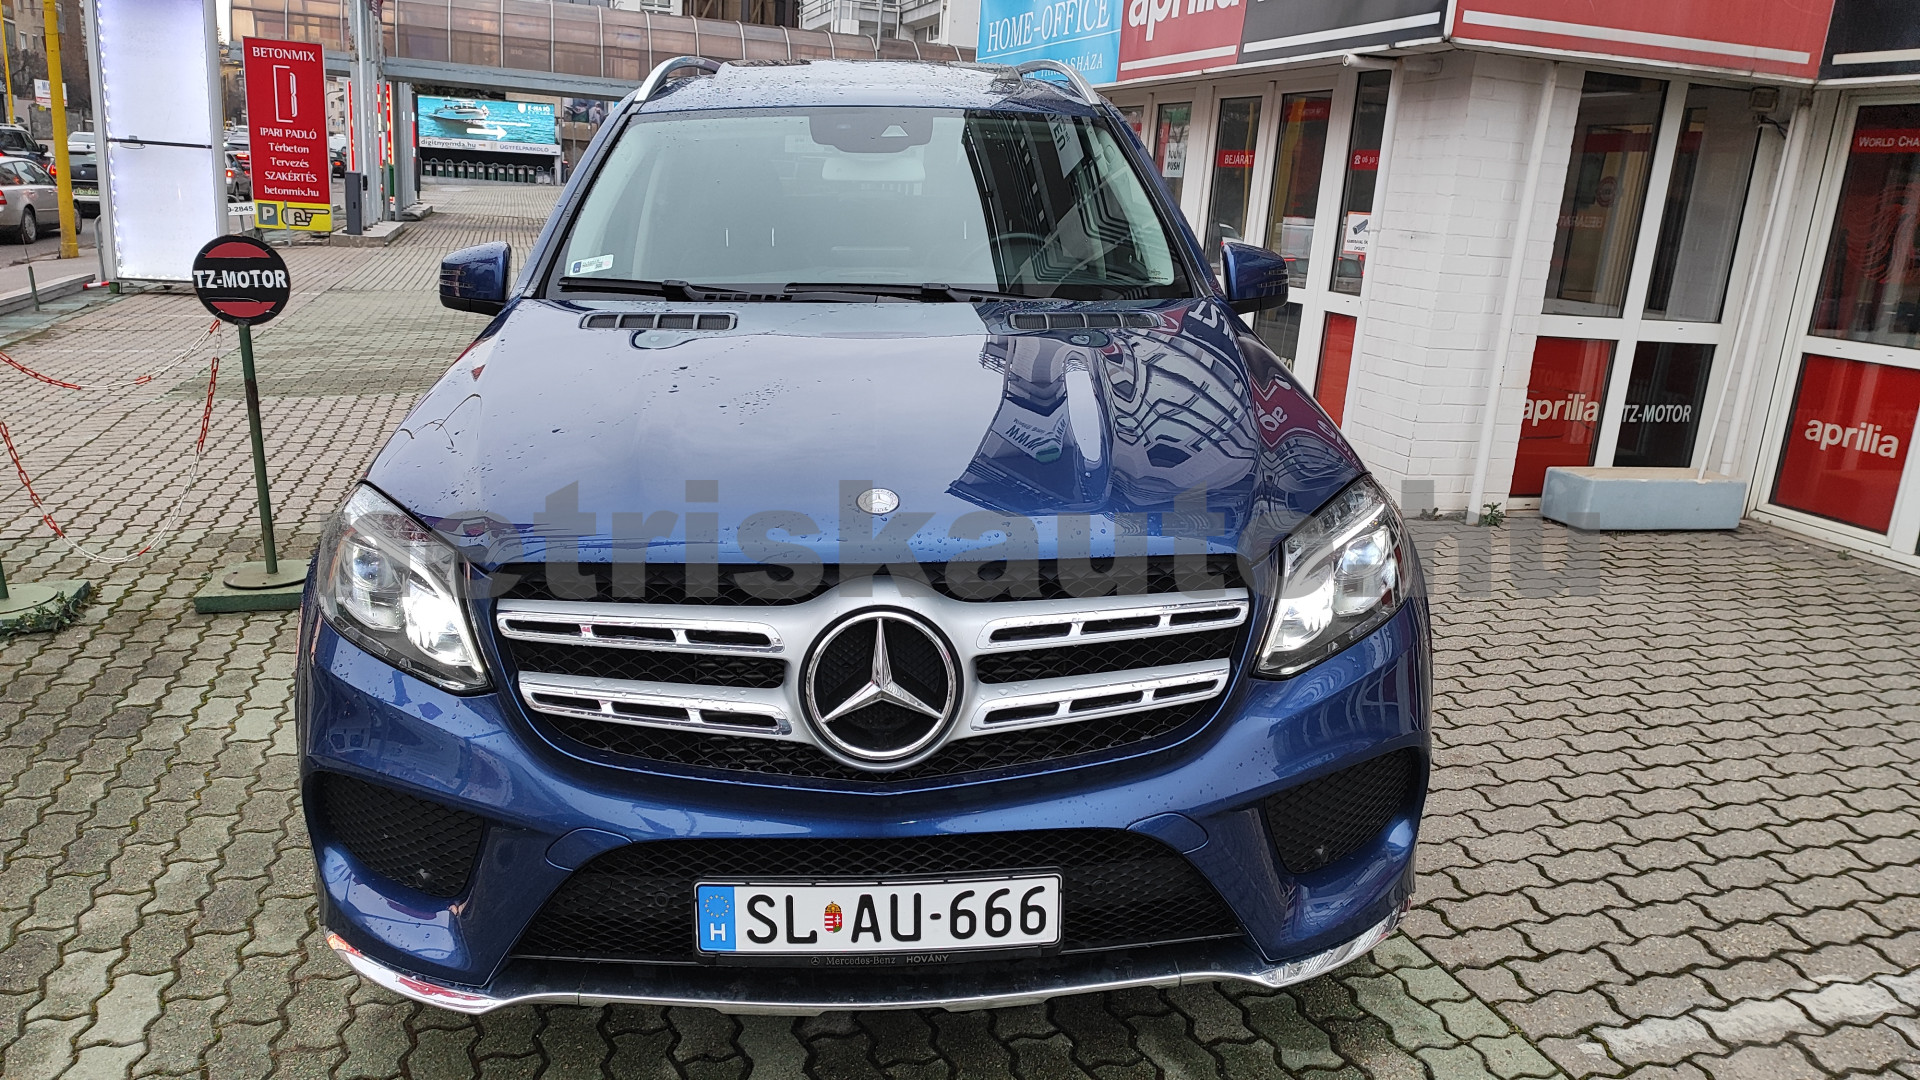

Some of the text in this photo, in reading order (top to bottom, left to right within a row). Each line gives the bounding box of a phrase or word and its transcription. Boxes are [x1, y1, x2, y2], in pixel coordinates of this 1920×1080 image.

[986, 0, 1110, 52] HOME-OFFICE
[252, 46, 316, 62] BETONMIX
[259, 127, 317, 139] IPARI PADLÓ
[268, 142, 309, 154] Térbeton
[421, 139, 476, 149] digitnyomda.hu
[1858, 136, 1896, 147] WORLD
[270, 157, 309, 168] Tervezés
[1224, 152, 1253, 165] BEJÁRAT
[1167, 161, 1181, 171] PUSH
[264, 170, 318, 183] SZAKÉRTÉS
[264, 185, 319, 197] betonmix.hu
[262, 206, 275, 221] P
[193, 269, 288, 289] TZ-MOTOR
[1522, 393, 1600, 426] aprilia
[1805, 418, 1900, 459] aprilia
[746, 885, 1047, 945] SL AU-666
[710, 923, 726, 942] H
[826, 954, 949, 966] Mercedes-Benz HOVÁNY
